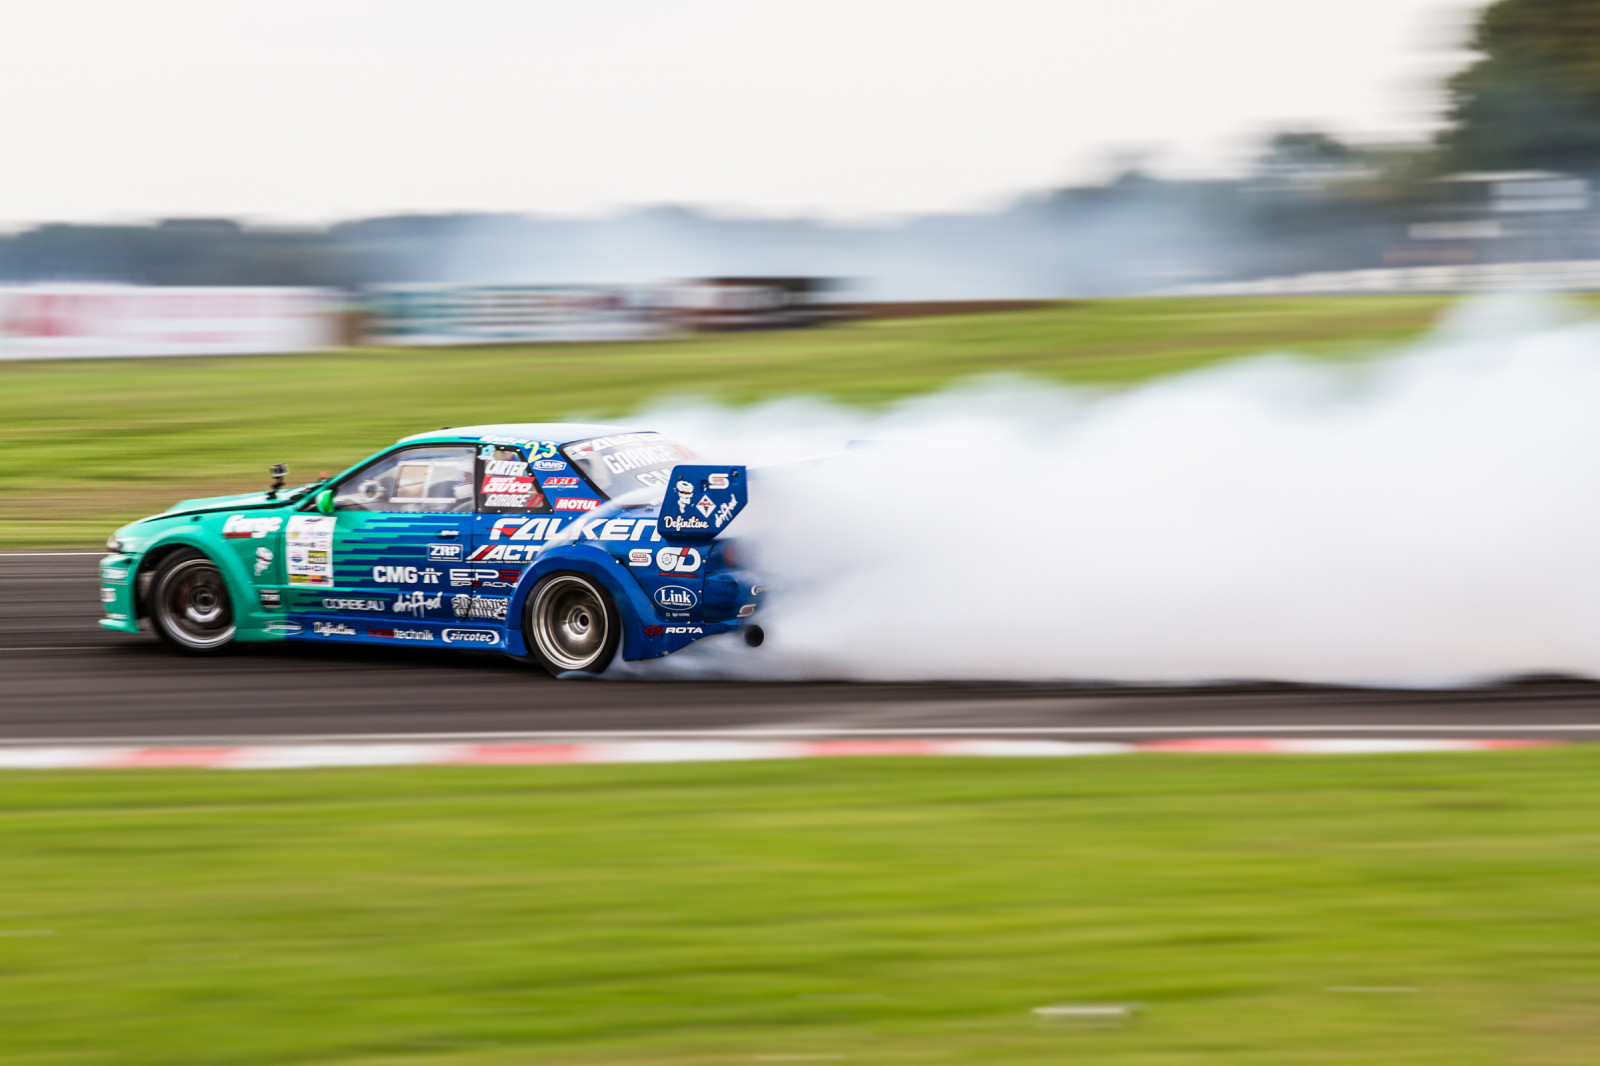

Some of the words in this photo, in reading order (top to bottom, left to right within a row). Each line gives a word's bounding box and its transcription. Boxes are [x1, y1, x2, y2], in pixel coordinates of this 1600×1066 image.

[524, 440, 557, 464] 23
[485, 460, 528, 477] CARTER
[543, 477, 580, 485] ARP
[556, 498, 599, 509] MOTUL
[663, 515, 709, 531] Definitive
[430, 545, 460, 556] ZRP
[373, 565, 418, 584] CMG
[660, 589, 692, 603] Link
[322, 598, 385, 611] CORBEAU
[393, 591, 443, 618] drifted
[665, 626, 703, 634] ROTA
[450, 632, 493, 642] zircotec
